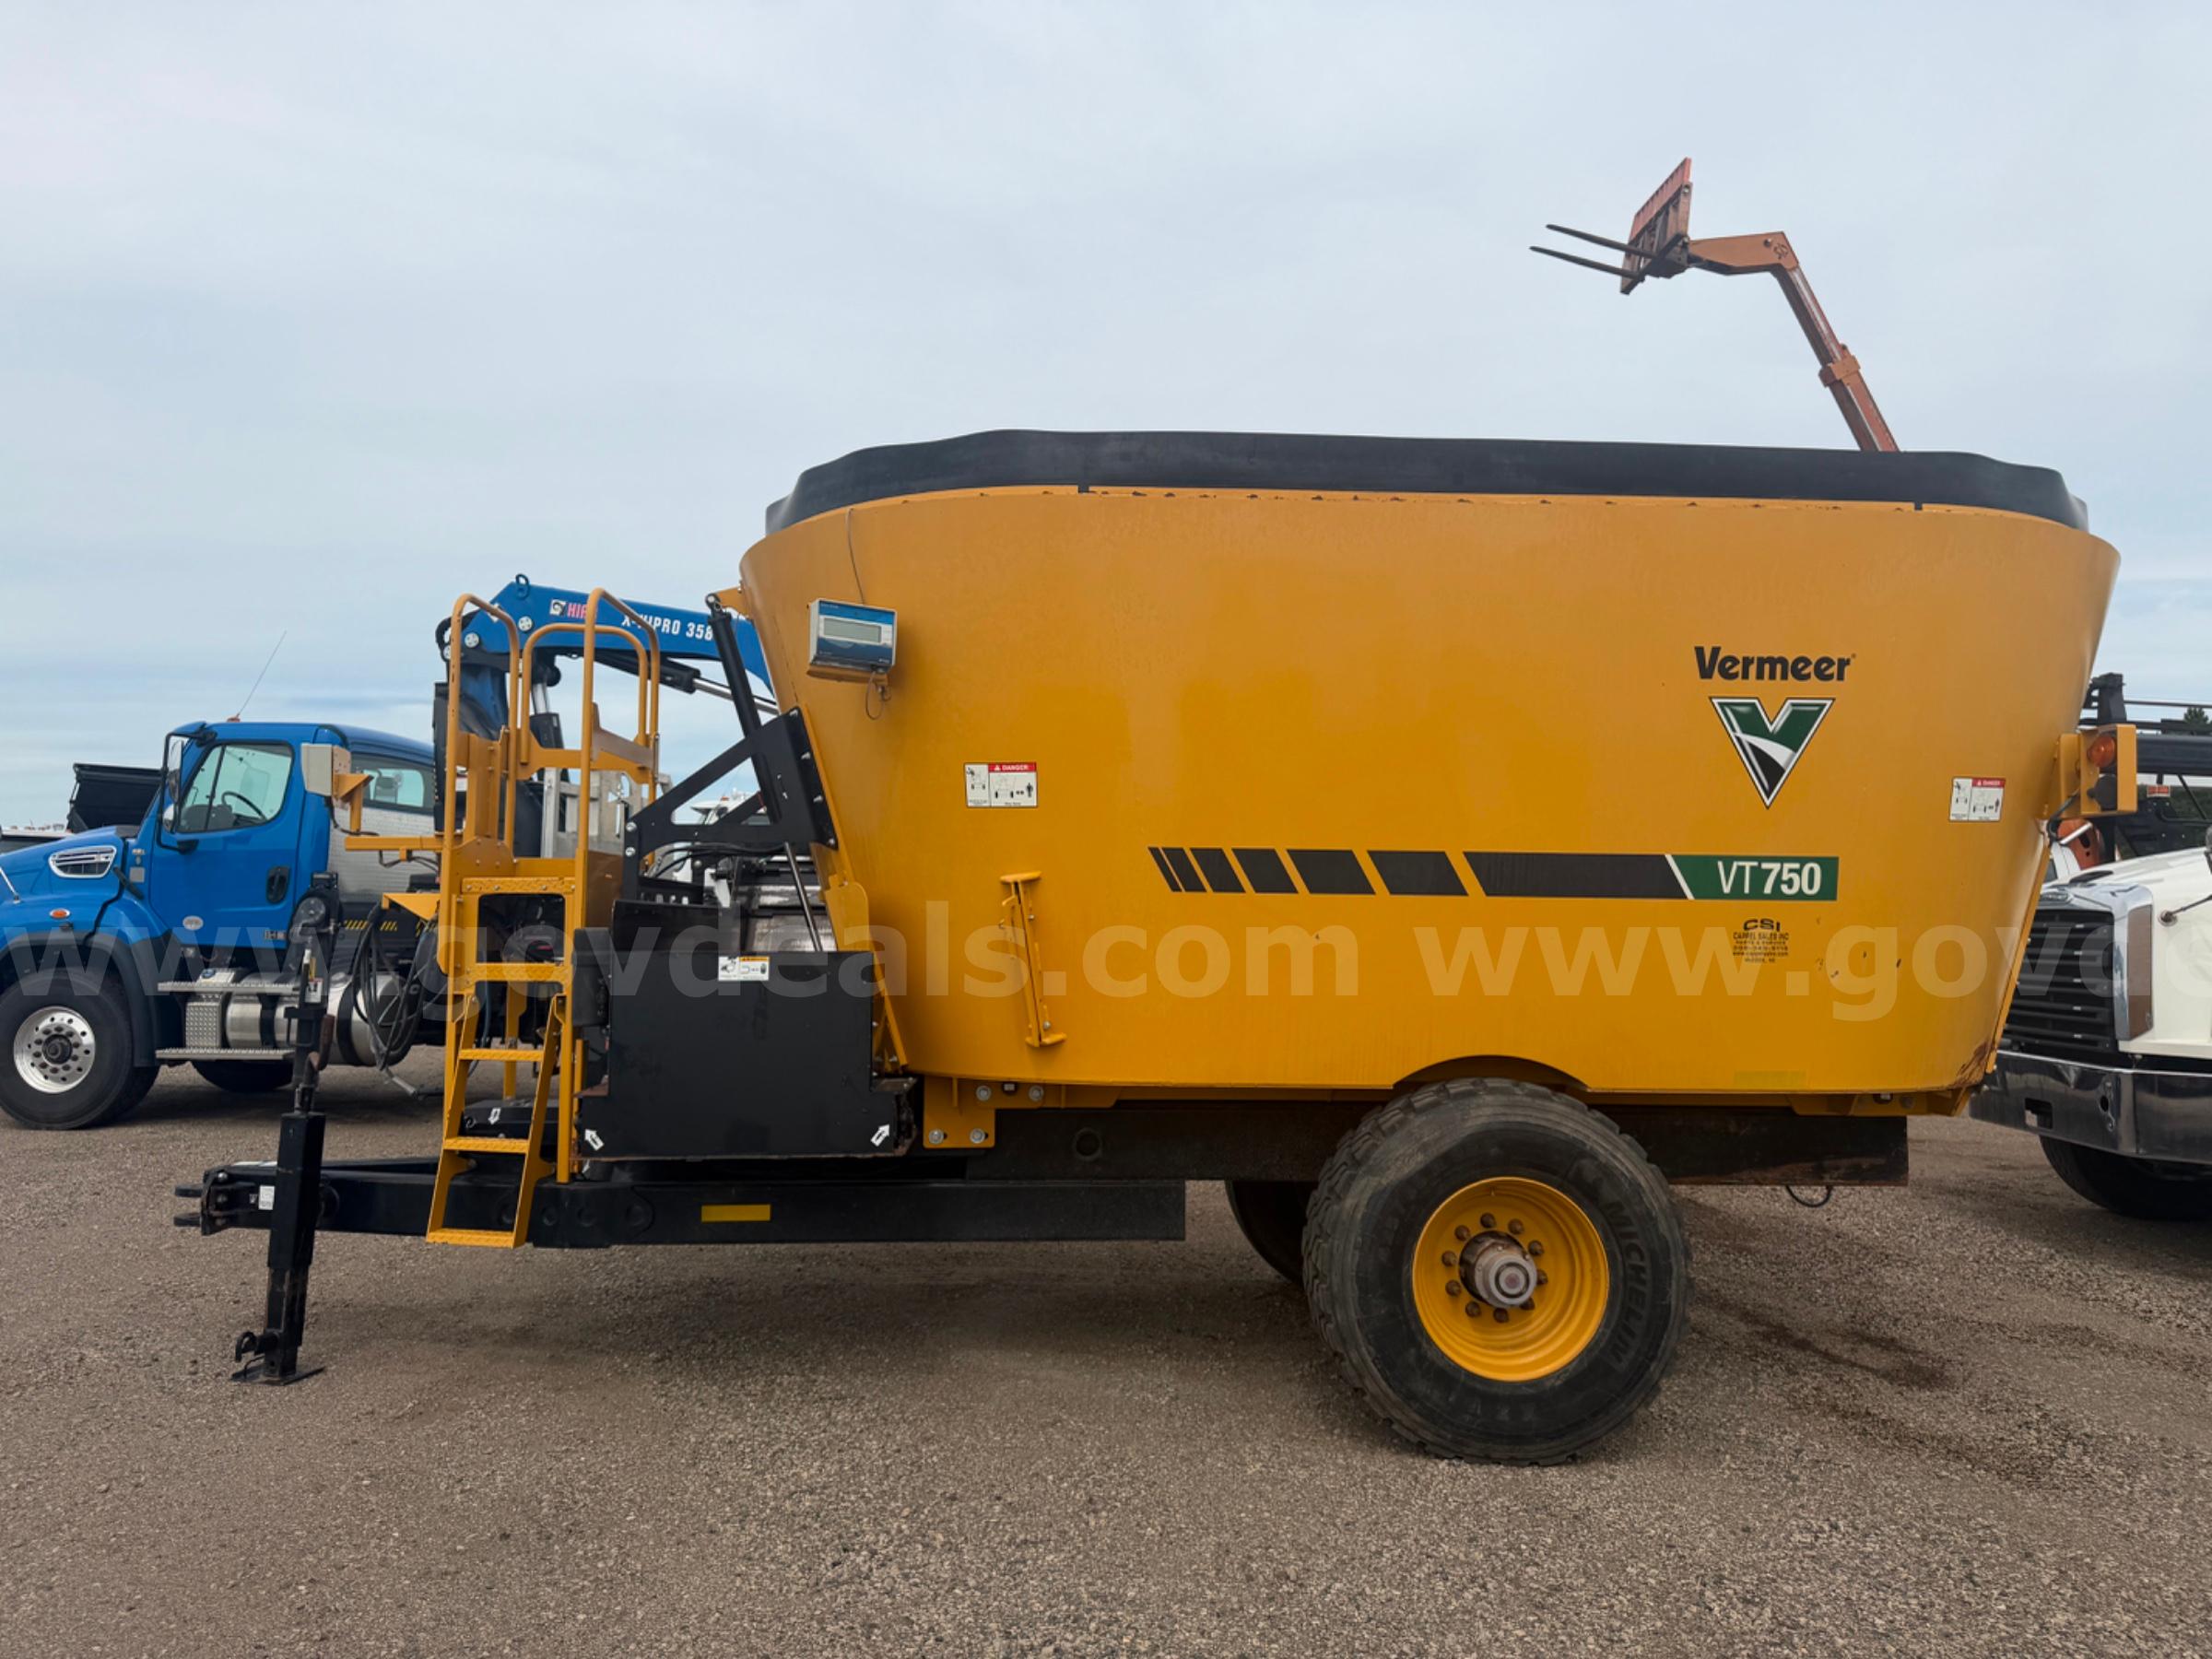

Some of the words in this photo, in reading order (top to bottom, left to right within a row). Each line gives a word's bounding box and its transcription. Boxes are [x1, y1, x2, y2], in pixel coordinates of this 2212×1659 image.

[1694, 646, 1851, 681] Vermeer
[1717, 861, 1822, 895] VT750
[1744, 918, 1781, 932] CSI
